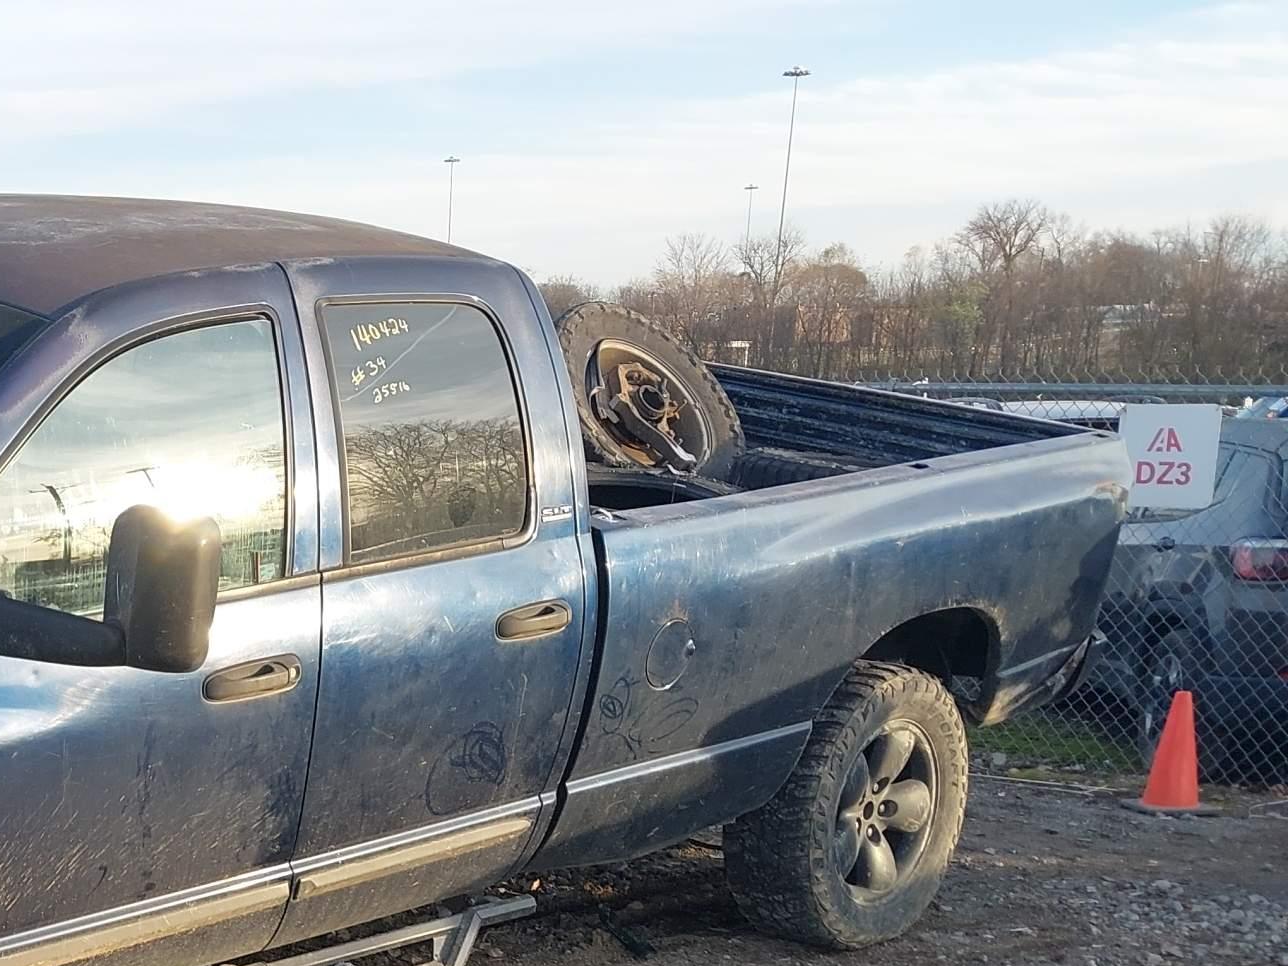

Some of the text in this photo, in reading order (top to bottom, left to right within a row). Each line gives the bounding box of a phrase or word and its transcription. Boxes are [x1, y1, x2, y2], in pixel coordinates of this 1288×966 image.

[350, 318, 409, 352] 140424
[372, 381, 410, 404] 25516
[1135, 460, 1192, 486] DZ3
[541, 505, 573, 517] SLT
